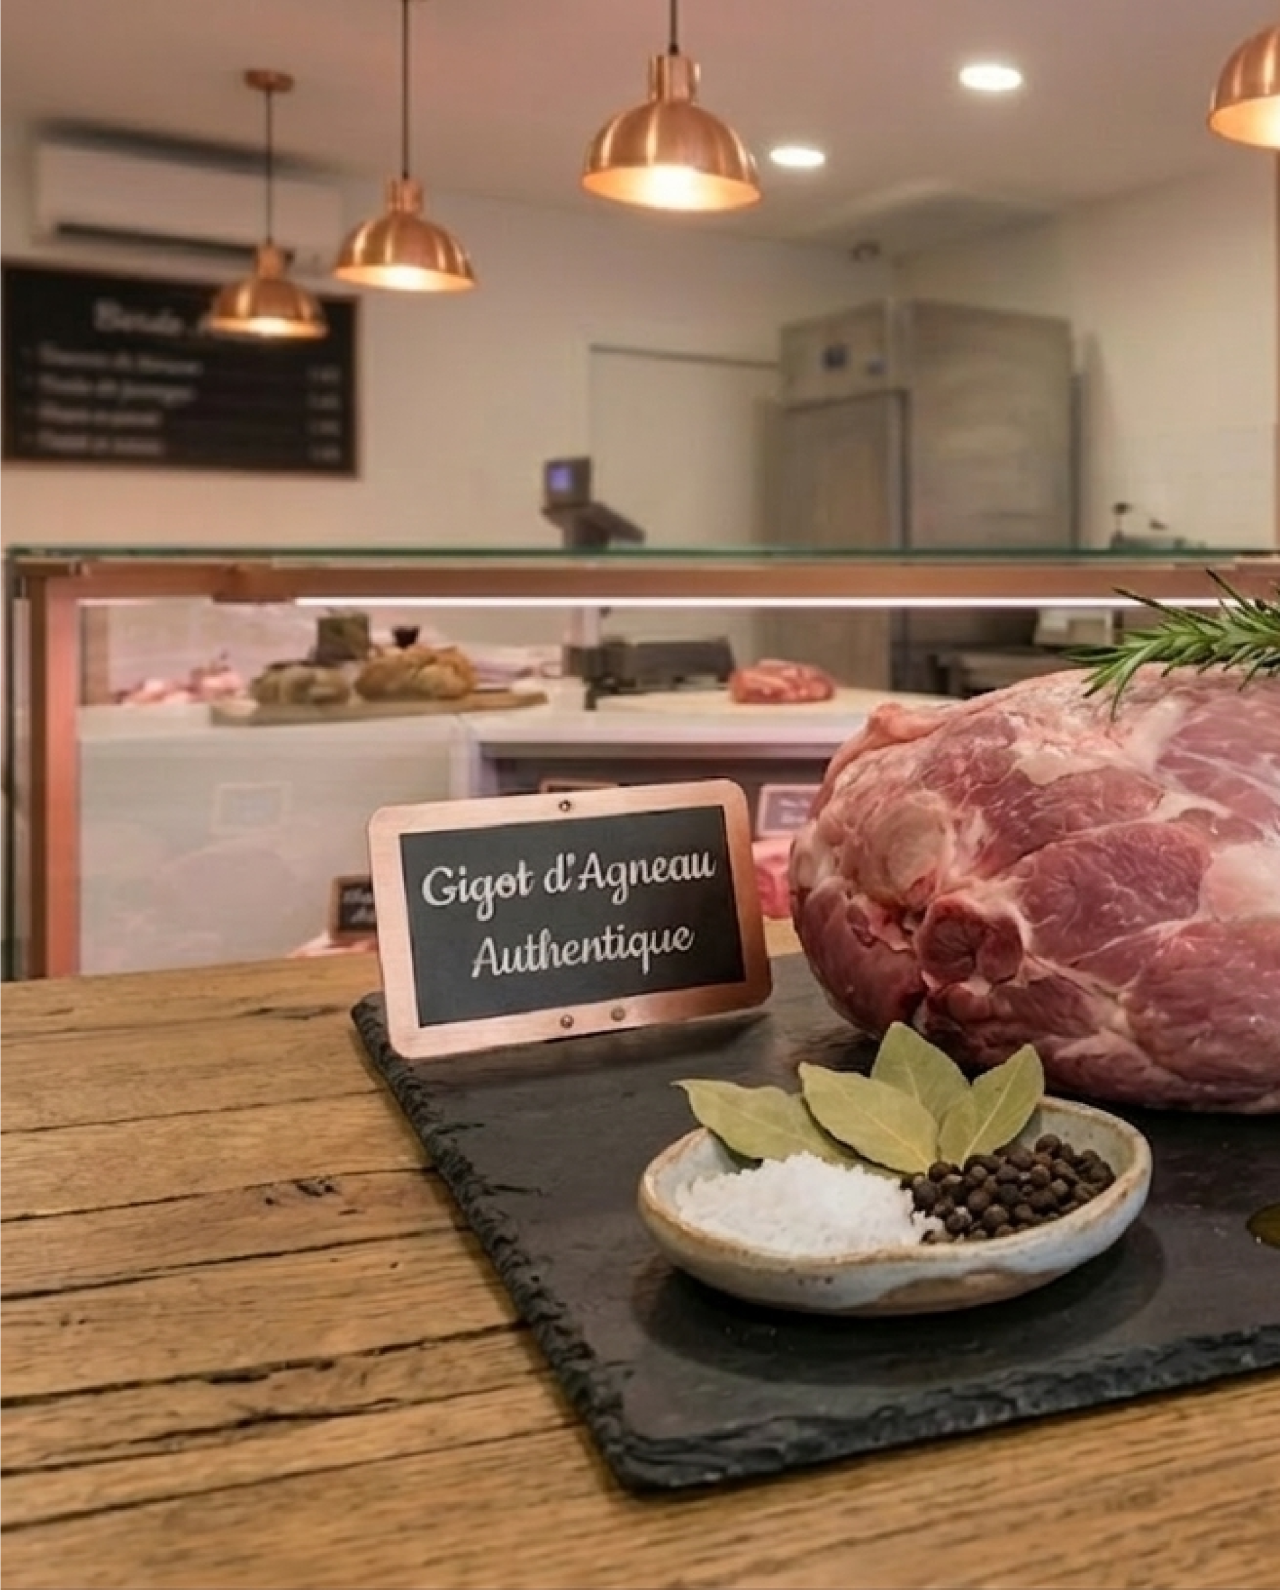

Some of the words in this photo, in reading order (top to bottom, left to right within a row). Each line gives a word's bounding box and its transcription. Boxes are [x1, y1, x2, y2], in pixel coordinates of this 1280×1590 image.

[421, 859, 535, 921] Gigot
[543, 851, 717, 905] d'Agneau
[471, 925, 695, 979] Authentique
